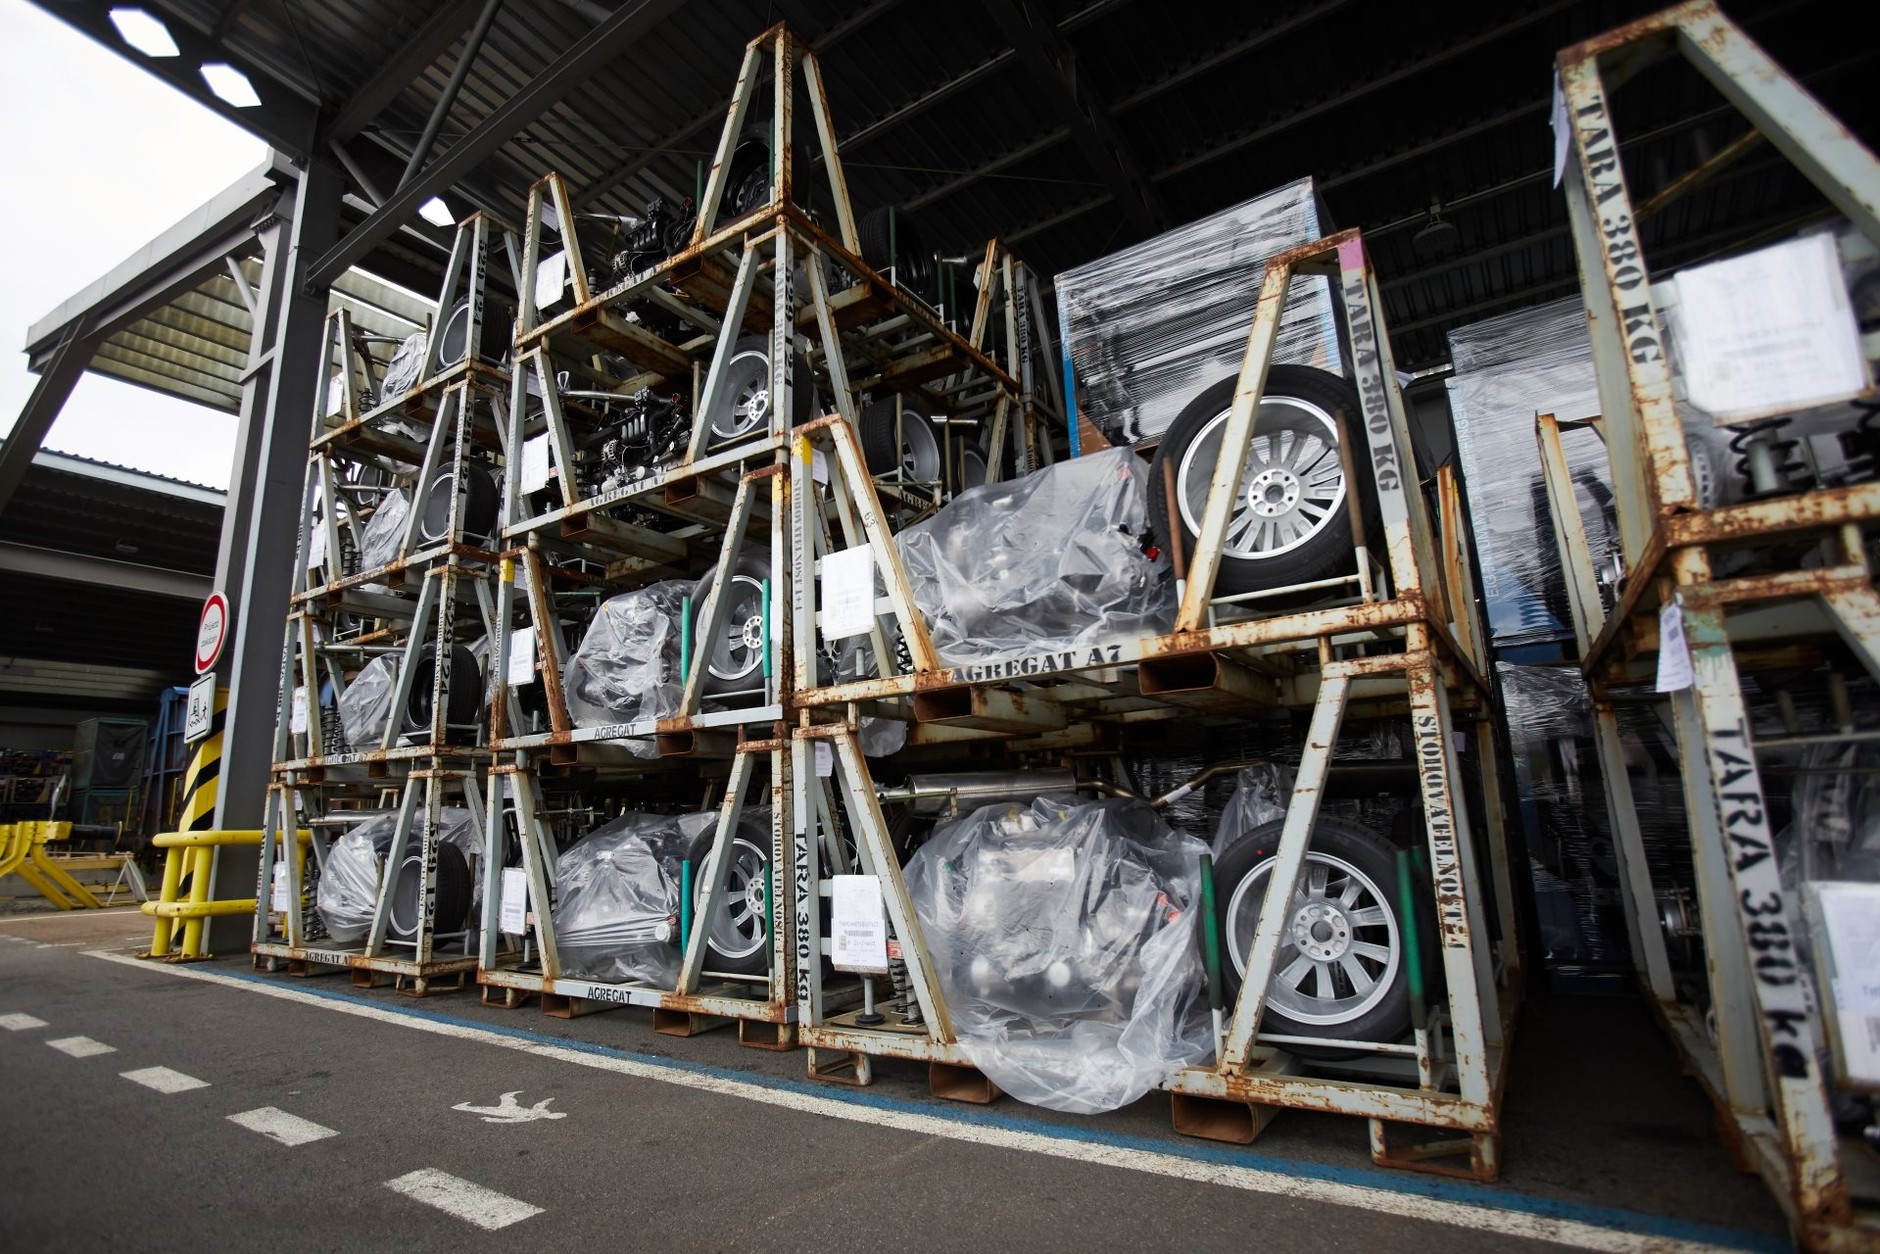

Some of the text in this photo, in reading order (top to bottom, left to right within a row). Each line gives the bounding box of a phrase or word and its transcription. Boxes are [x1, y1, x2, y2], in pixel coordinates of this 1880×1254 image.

[1577, 95, 1662, 366] TARA 380 KG
[477, 240, 488, 280] 529
[785, 266, 794, 322] 529
[775, 263, 784, 386] TARA 380 KG
[1017, 285, 1029, 364] TARA 380 KG
[1345, 279, 1400, 493] TARA 380 KG
[462, 400, 474, 445] 529
[794, 479, 803, 585] STOHOVATELNOST
[951, 644, 1122, 684] AGREGAT A7
[594, 723, 637, 739] AGREGAT
[428, 823, 439, 864] 529
[796, 828, 809, 903] TARA
[1709, 718, 1771, 873] TARA
[1740, 887, 1796, 987] 380
[305, 951, 341, 964] AGREGAT
[797, 912, 810, 959] 380
[587, 986, 632, 1004] AGREGAT
